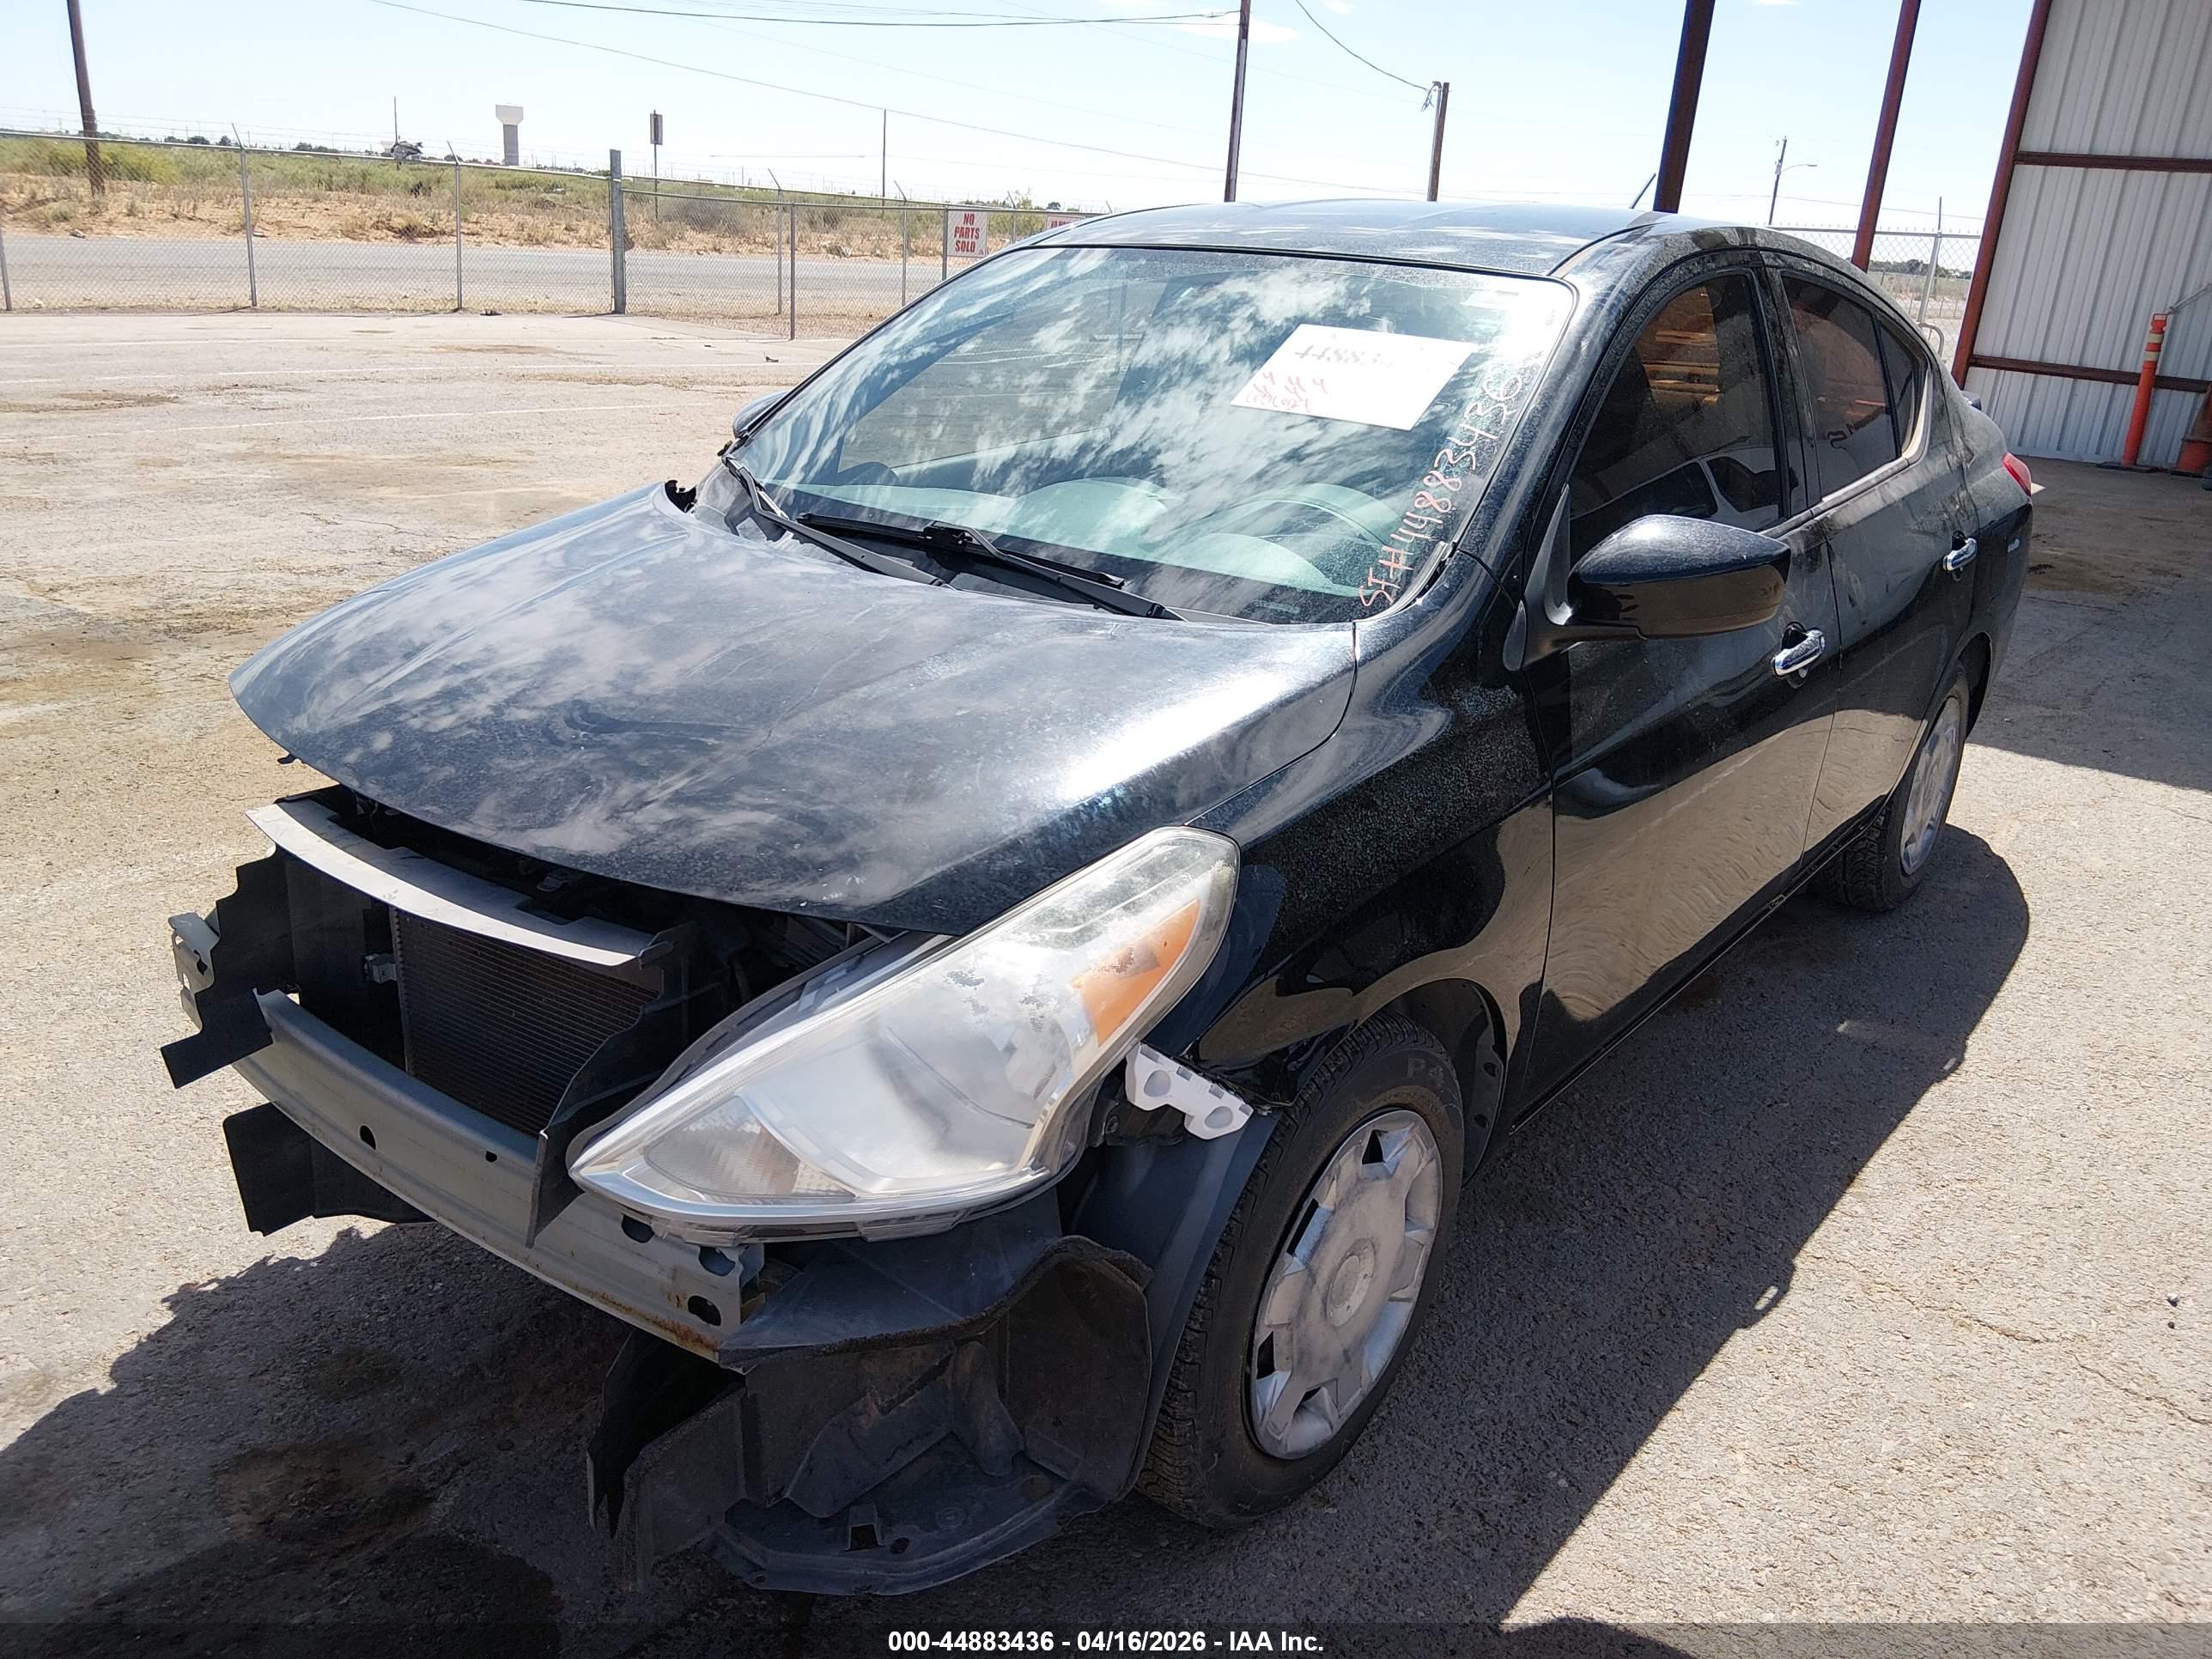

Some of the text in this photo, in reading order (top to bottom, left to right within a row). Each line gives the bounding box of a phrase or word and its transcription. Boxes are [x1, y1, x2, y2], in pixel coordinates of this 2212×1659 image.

[963, 213, 975, 225] NO
[954, 226, 980, 240] PARTS
[955, 240, 975, 252] SOLD
